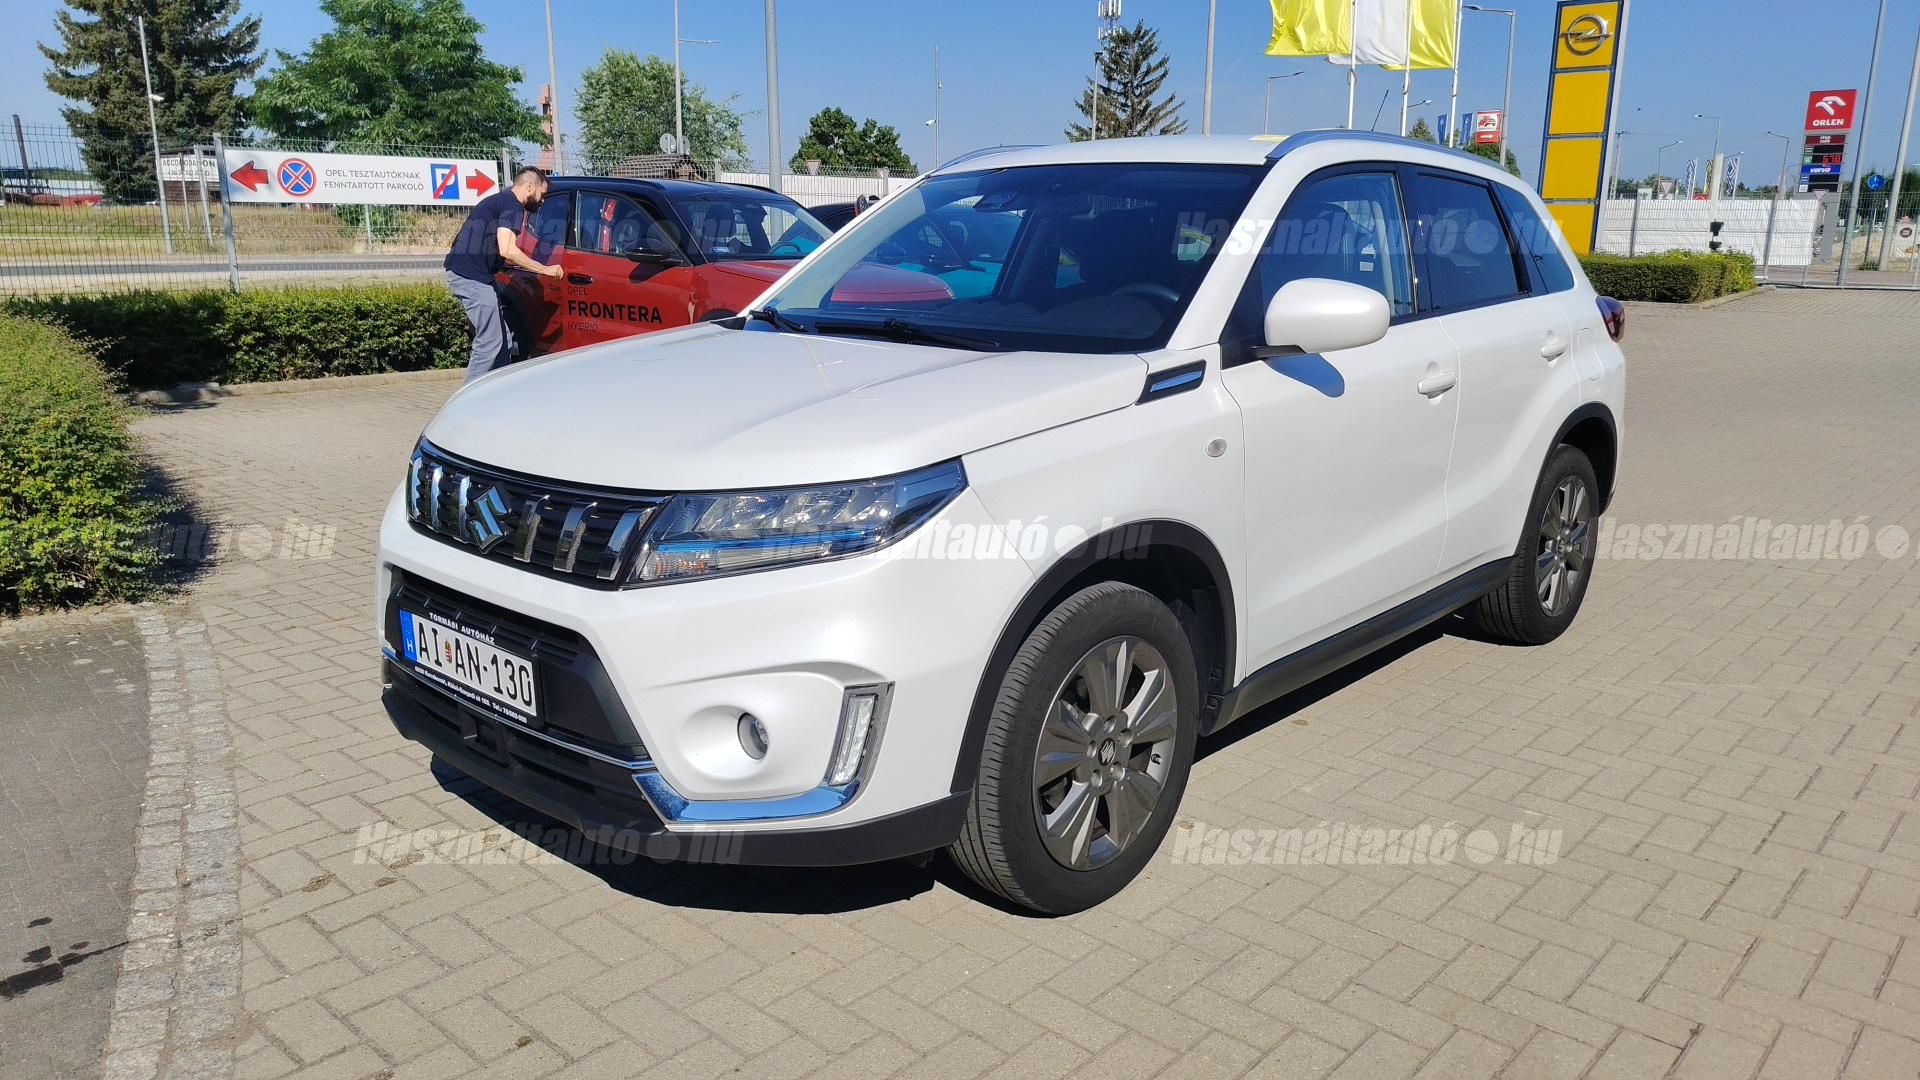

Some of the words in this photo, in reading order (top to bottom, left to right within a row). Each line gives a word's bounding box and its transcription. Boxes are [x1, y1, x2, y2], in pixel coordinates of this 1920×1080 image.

[325, 169, 347, 177] OPEL
[349, 168, 420, 179] TESZTAUTÓKNAK
[324, 181, 384, 190] FENNTARTOTT
[386, 182, 424, 191] PARKOLÓ
[568, 286, 588, 296] OPEL
[567, 299, 663, 324] FRONTERA
[568, 321, 598, 332] HYBRID
[428, 612, 459, 630] TORMÁSI
[461, 625, 496, 645] AUTÓHÁZ
[406, 639, 414, 654] H
